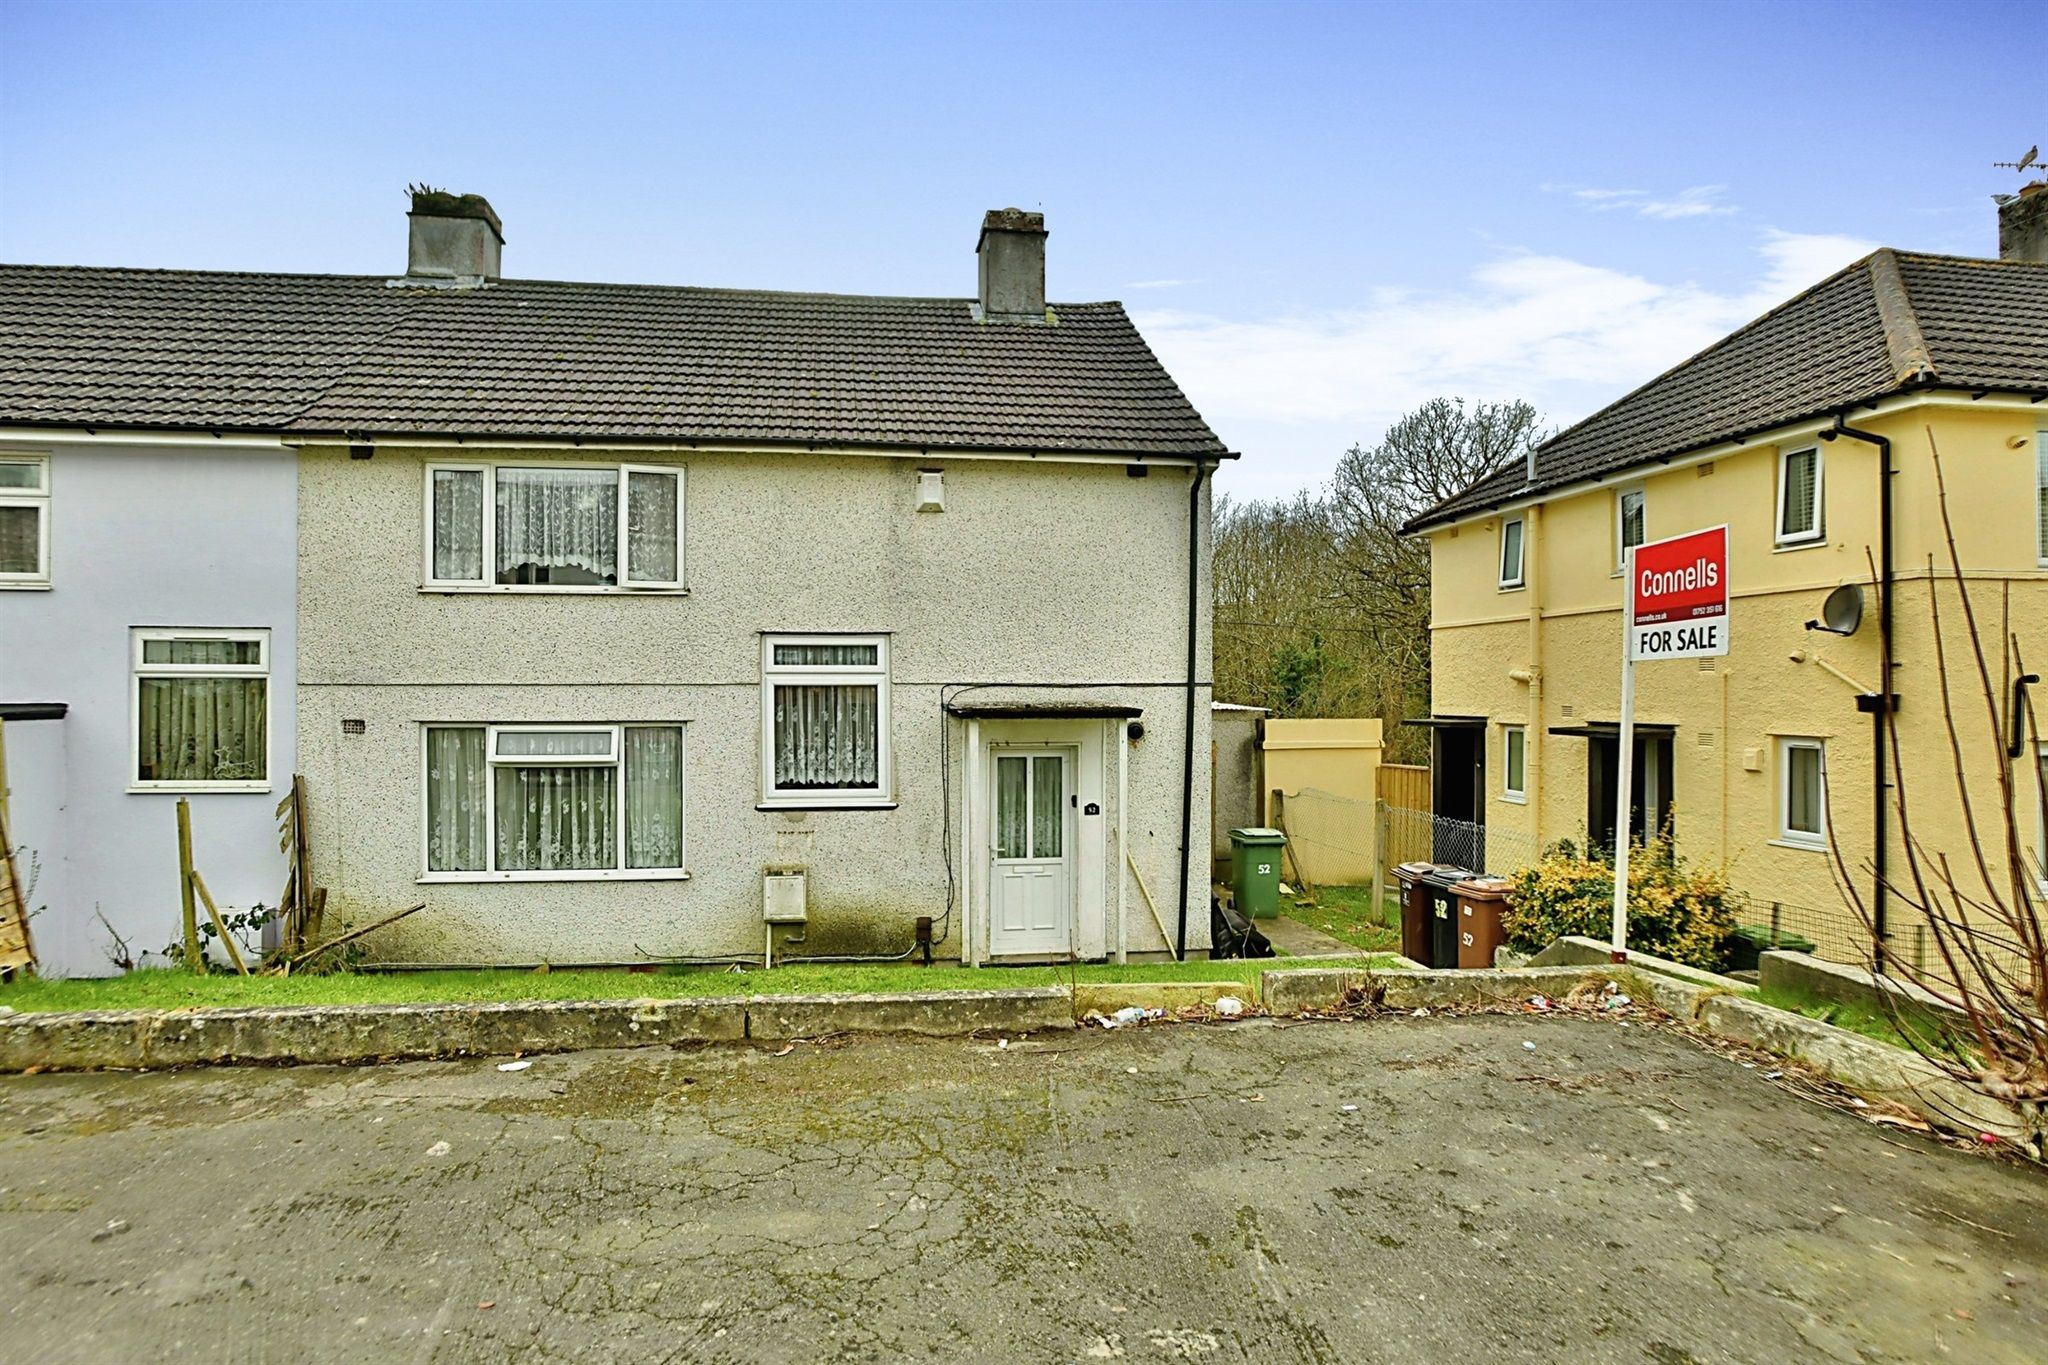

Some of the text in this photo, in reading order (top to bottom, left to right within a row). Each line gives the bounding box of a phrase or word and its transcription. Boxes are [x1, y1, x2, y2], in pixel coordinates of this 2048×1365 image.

[1641, 558, 1718, 598] Connells
[1640, 625, 1717, 654] FOR SALE
[1258, 864, 1271, 874] 52
